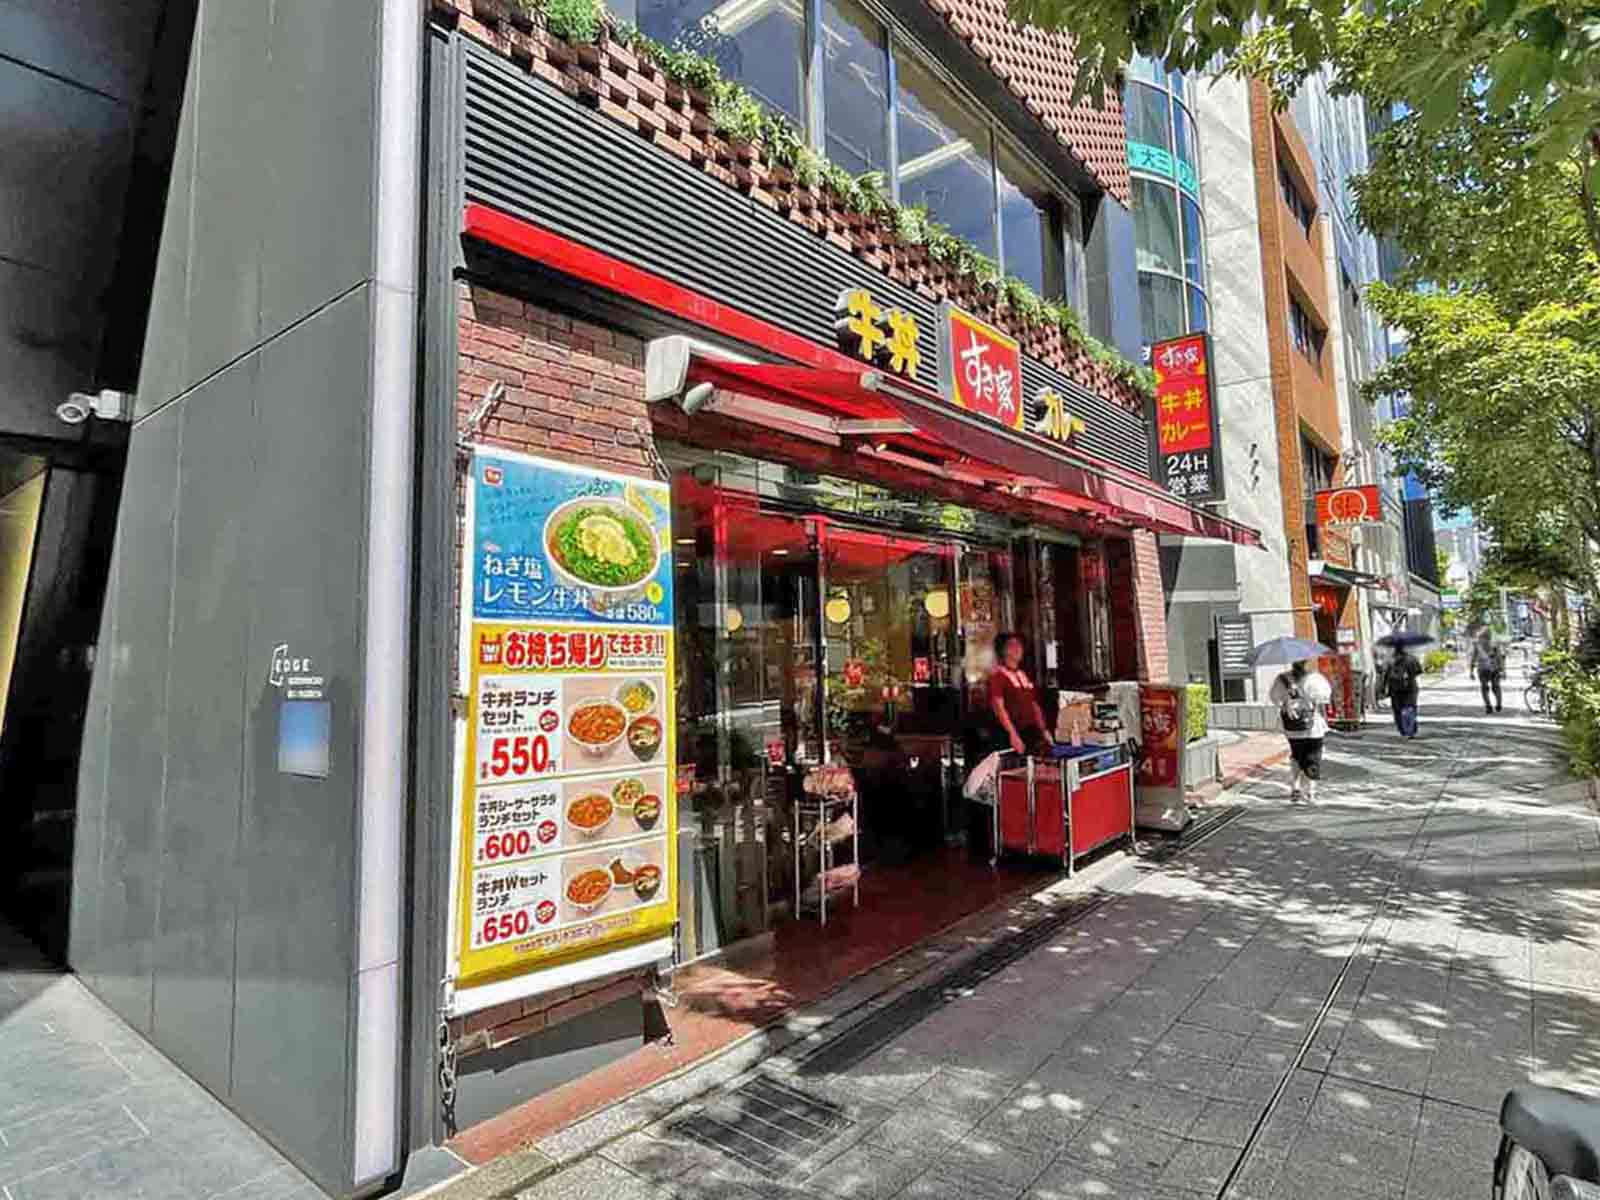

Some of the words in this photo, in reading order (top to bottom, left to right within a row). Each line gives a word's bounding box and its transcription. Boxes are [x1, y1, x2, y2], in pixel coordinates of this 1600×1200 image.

[842, 288, 921, 380] 牛丼
[960, 330, 1015, 413] すき家
[1161, 387, 1202, 414] 牛丼
[1042, 389, 1086, 441] カレー
[1161, 421, 1207, 444] カレー
[1167, 453, 1208, 475] 24H
[1167, 474, 1209, 496] 営業
[483, 554, 542, 579] ねぎ塩
[484, 578, 590, 609] レモン牛丼
[627, 603, 657, 622] 580
[482, 690, 557, 708] 牛丼ランチ
[482, 709, 524, 726] セット
[490, 735, 549, 777] 550
[485, 830, 530, 860] 600
[477, 872, 549, 896] 牛丼Wセット
[477, 893, 510, 911] ランチ
[483, 911, 529, 943] 650
